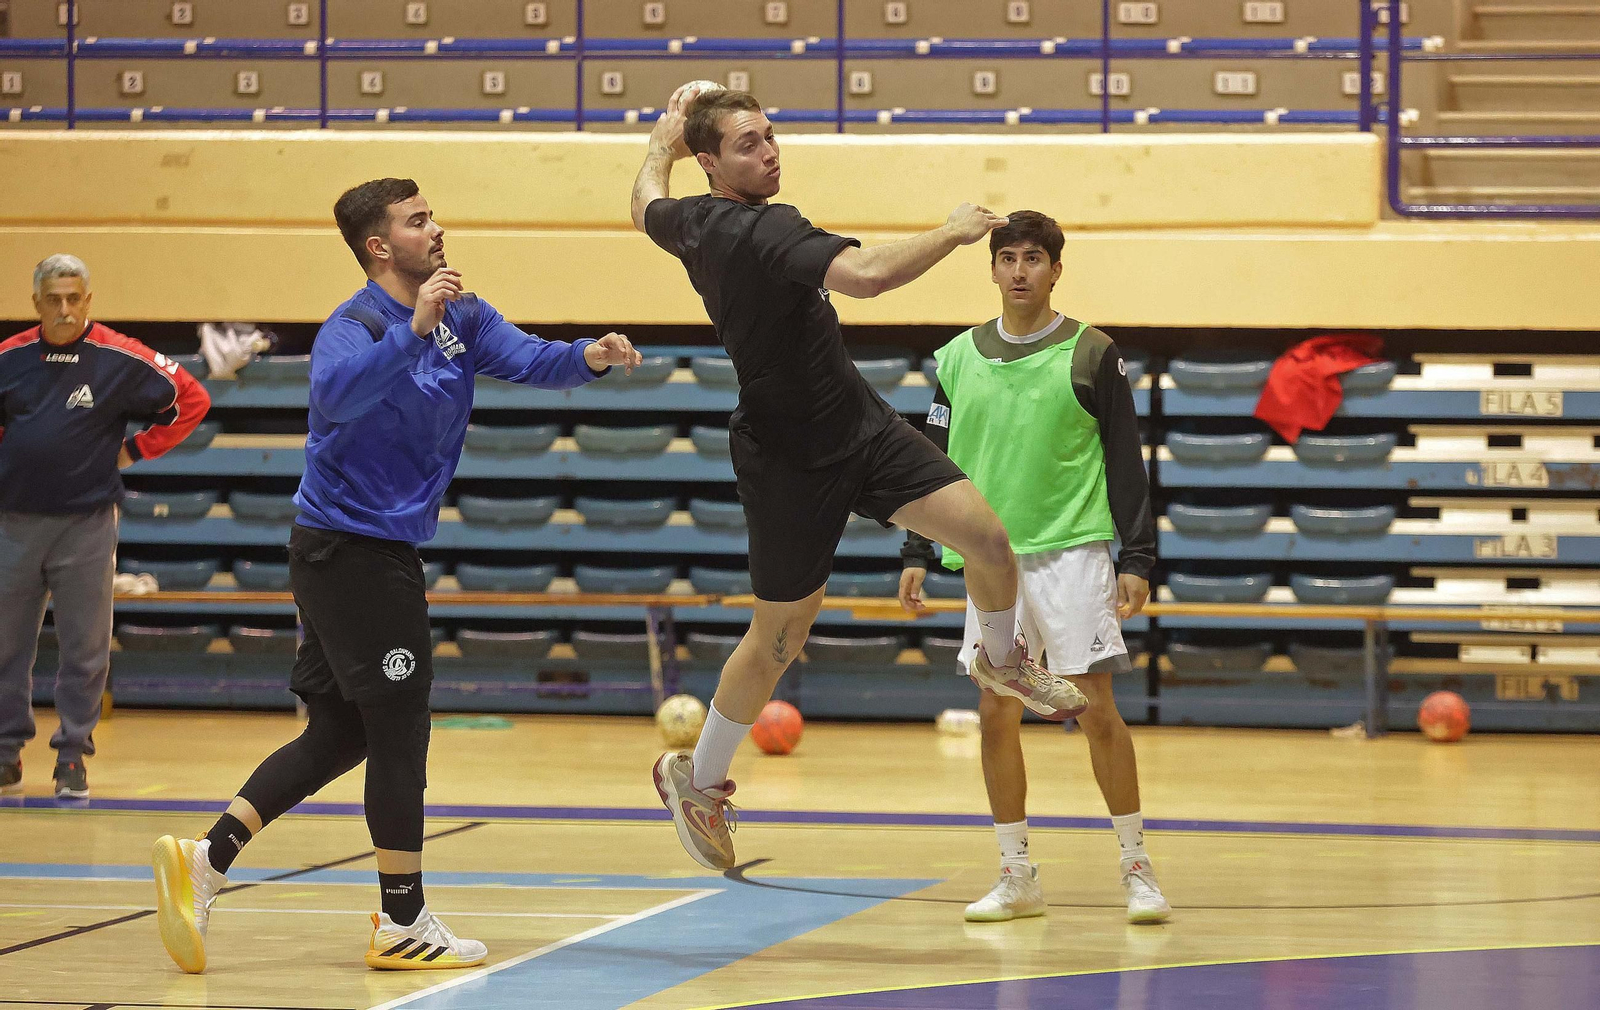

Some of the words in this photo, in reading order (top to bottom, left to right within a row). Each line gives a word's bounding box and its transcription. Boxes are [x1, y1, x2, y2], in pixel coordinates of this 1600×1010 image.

[1485, 388, 1538, 415] FILA
[1544, 391, 1560, 416] 5
[1468, 461, 1523, 486] ILA
[1529, 461, 1546, 486] 4
[1541, 531, 1556, 557] 3
